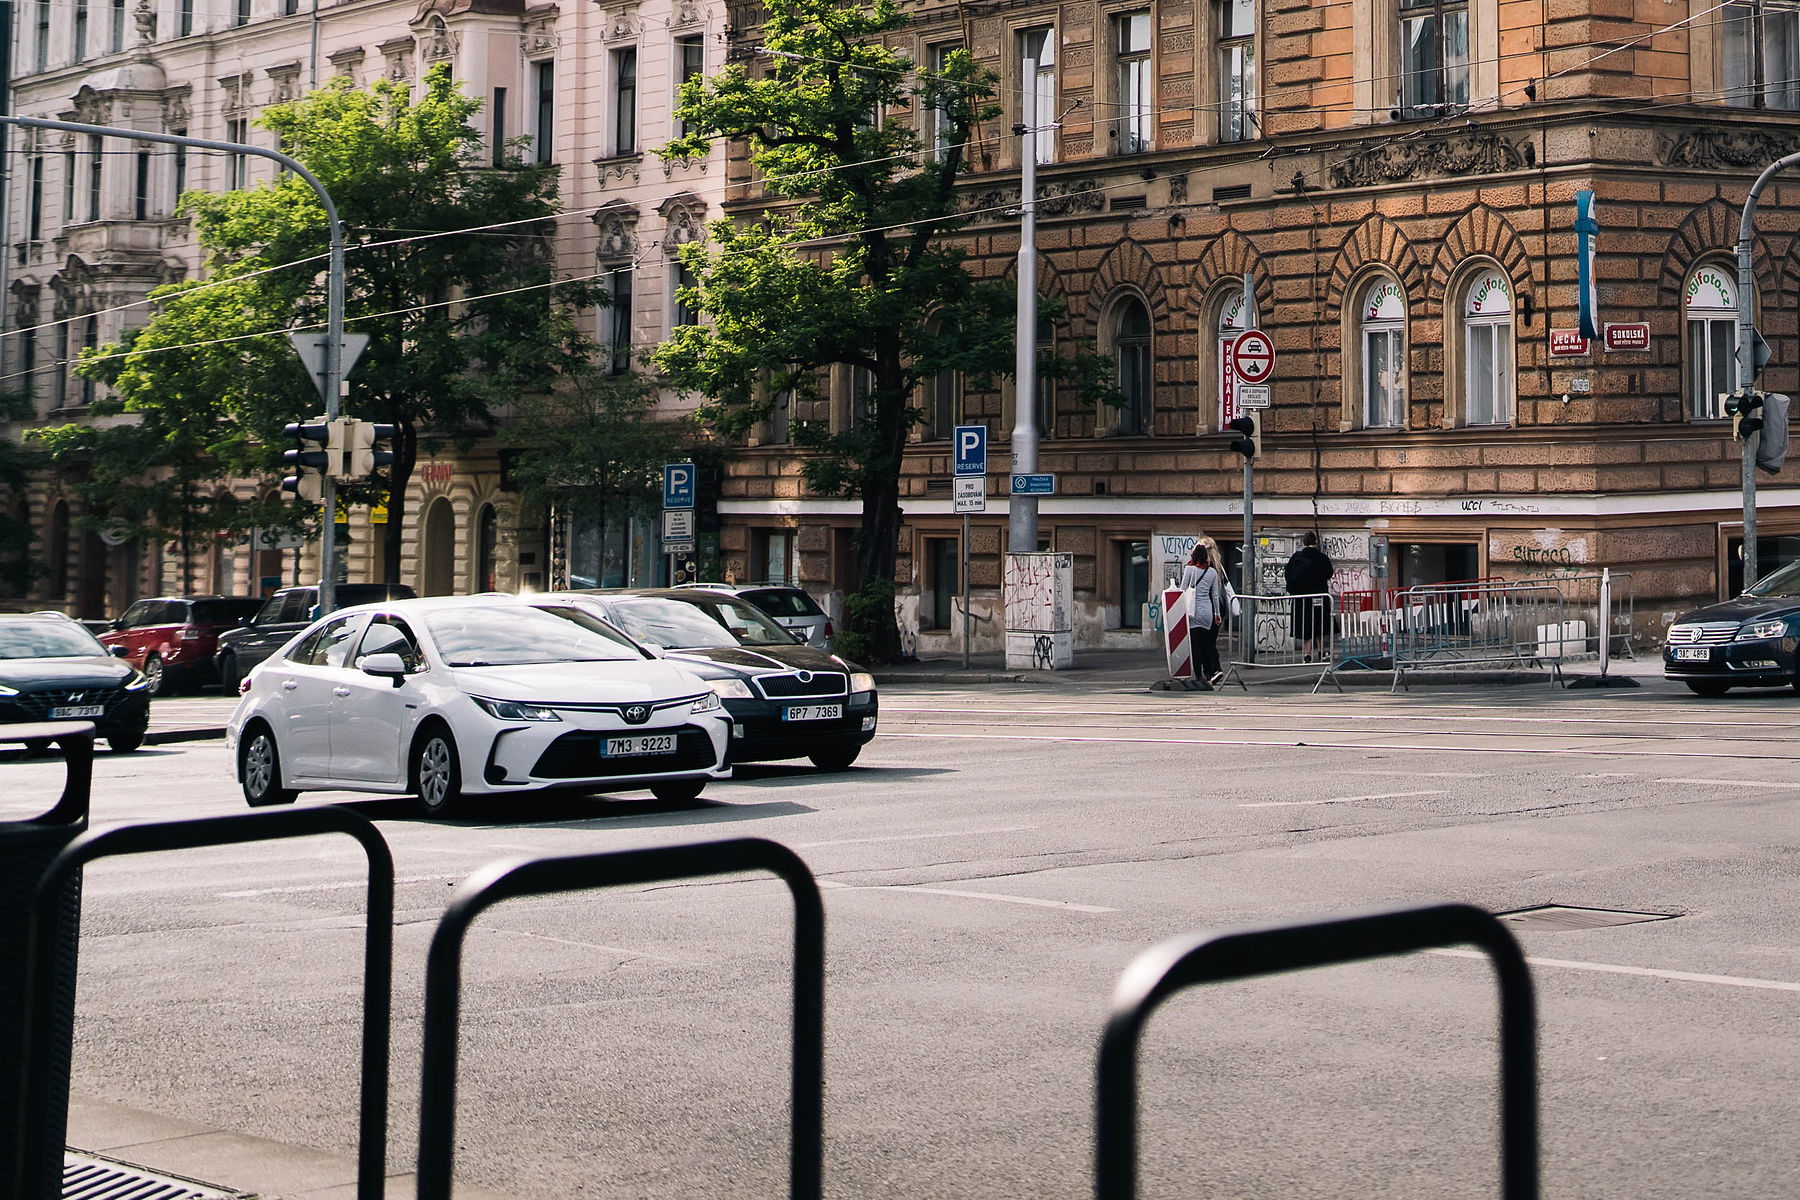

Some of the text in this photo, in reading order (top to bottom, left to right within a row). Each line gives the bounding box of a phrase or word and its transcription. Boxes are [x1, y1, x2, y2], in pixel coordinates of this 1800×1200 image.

[1613, 328, 1645, 339] SOKOLSKÁ
[961, 431, 980, 460] P
[670, 469, 688, 495] P
[789, 706, 838, 719] 6P7 7369
[609, 737, 671, 753] 7M3 9223
